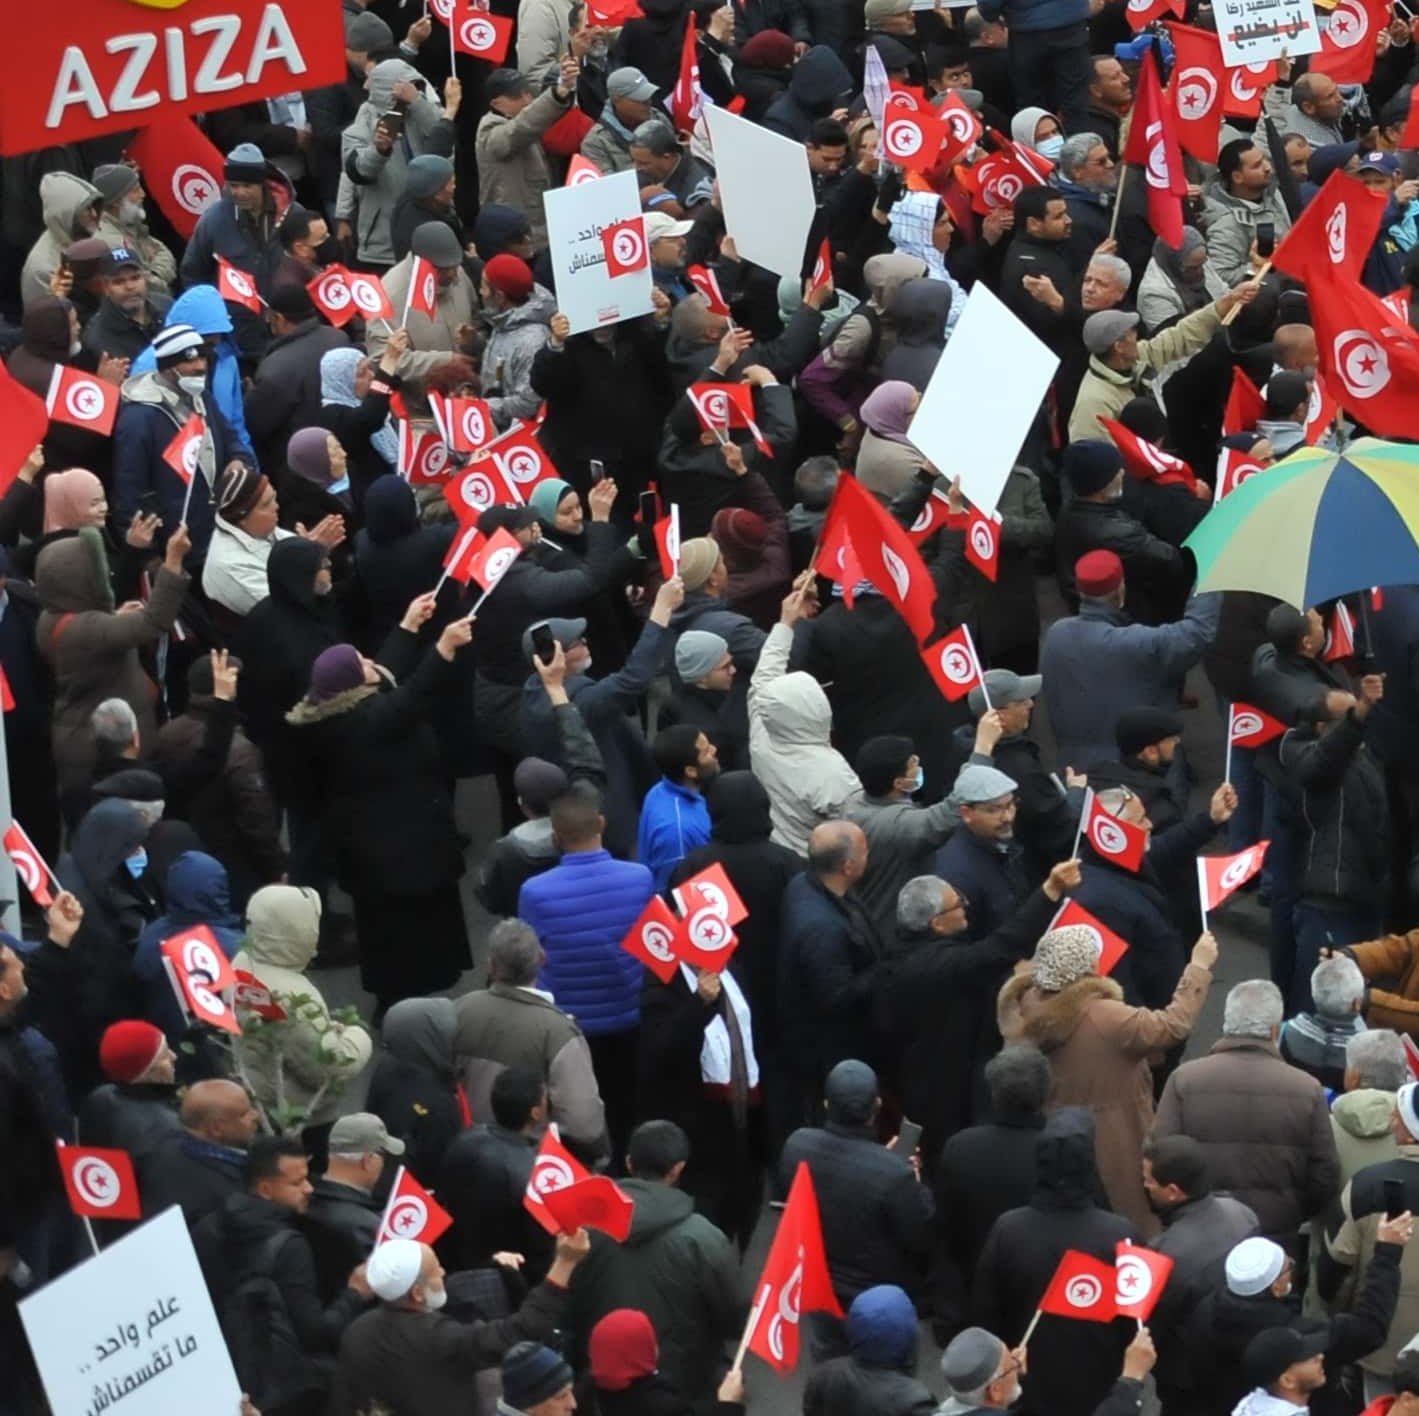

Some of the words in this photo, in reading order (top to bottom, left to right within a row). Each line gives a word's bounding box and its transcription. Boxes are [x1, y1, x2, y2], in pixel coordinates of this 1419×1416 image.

[45, 2, 307, 128] AZIZA
[147, 1295, 181, 1338] علم
[95, 1324, 140, 1361] واحد
[174, 1332, 198, 1359] ما
